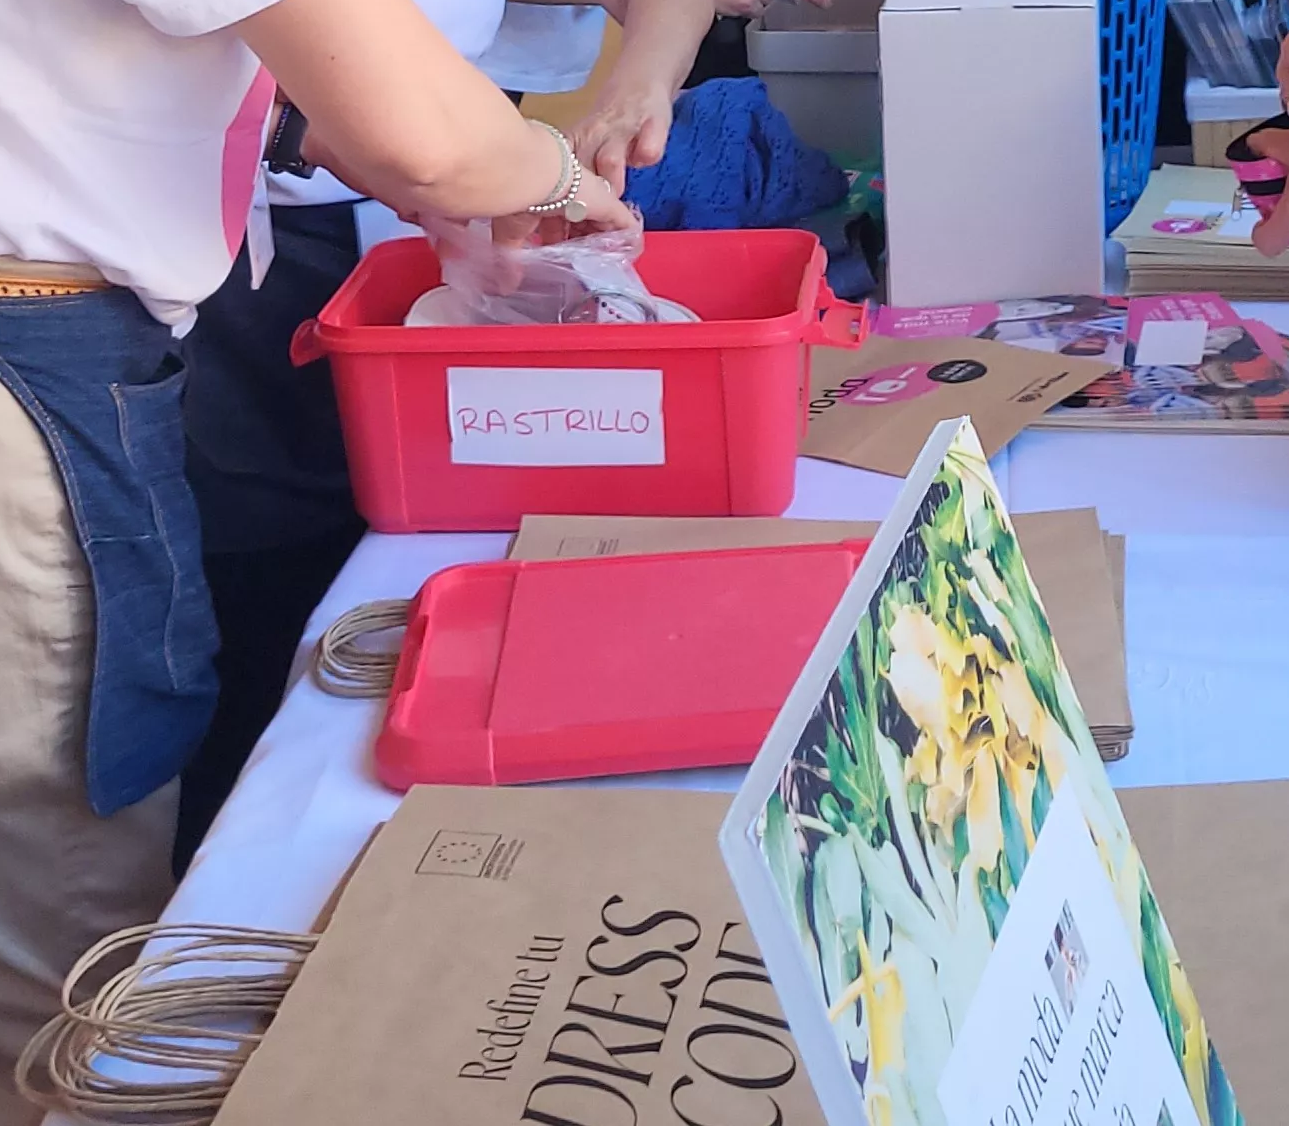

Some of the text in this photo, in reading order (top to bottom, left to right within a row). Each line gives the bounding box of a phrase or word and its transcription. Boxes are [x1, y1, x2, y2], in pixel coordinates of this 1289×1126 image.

[457, 407, 650, 435] RASTRILLO
[458, 968, 550, 1081] Redefine
[516, 934, 566, 963] tu
[520, 895, 702, 1126] DRESS
[1017, 992, 1064, 1124] moda
[1080, 979, 1125, 1111] marca
